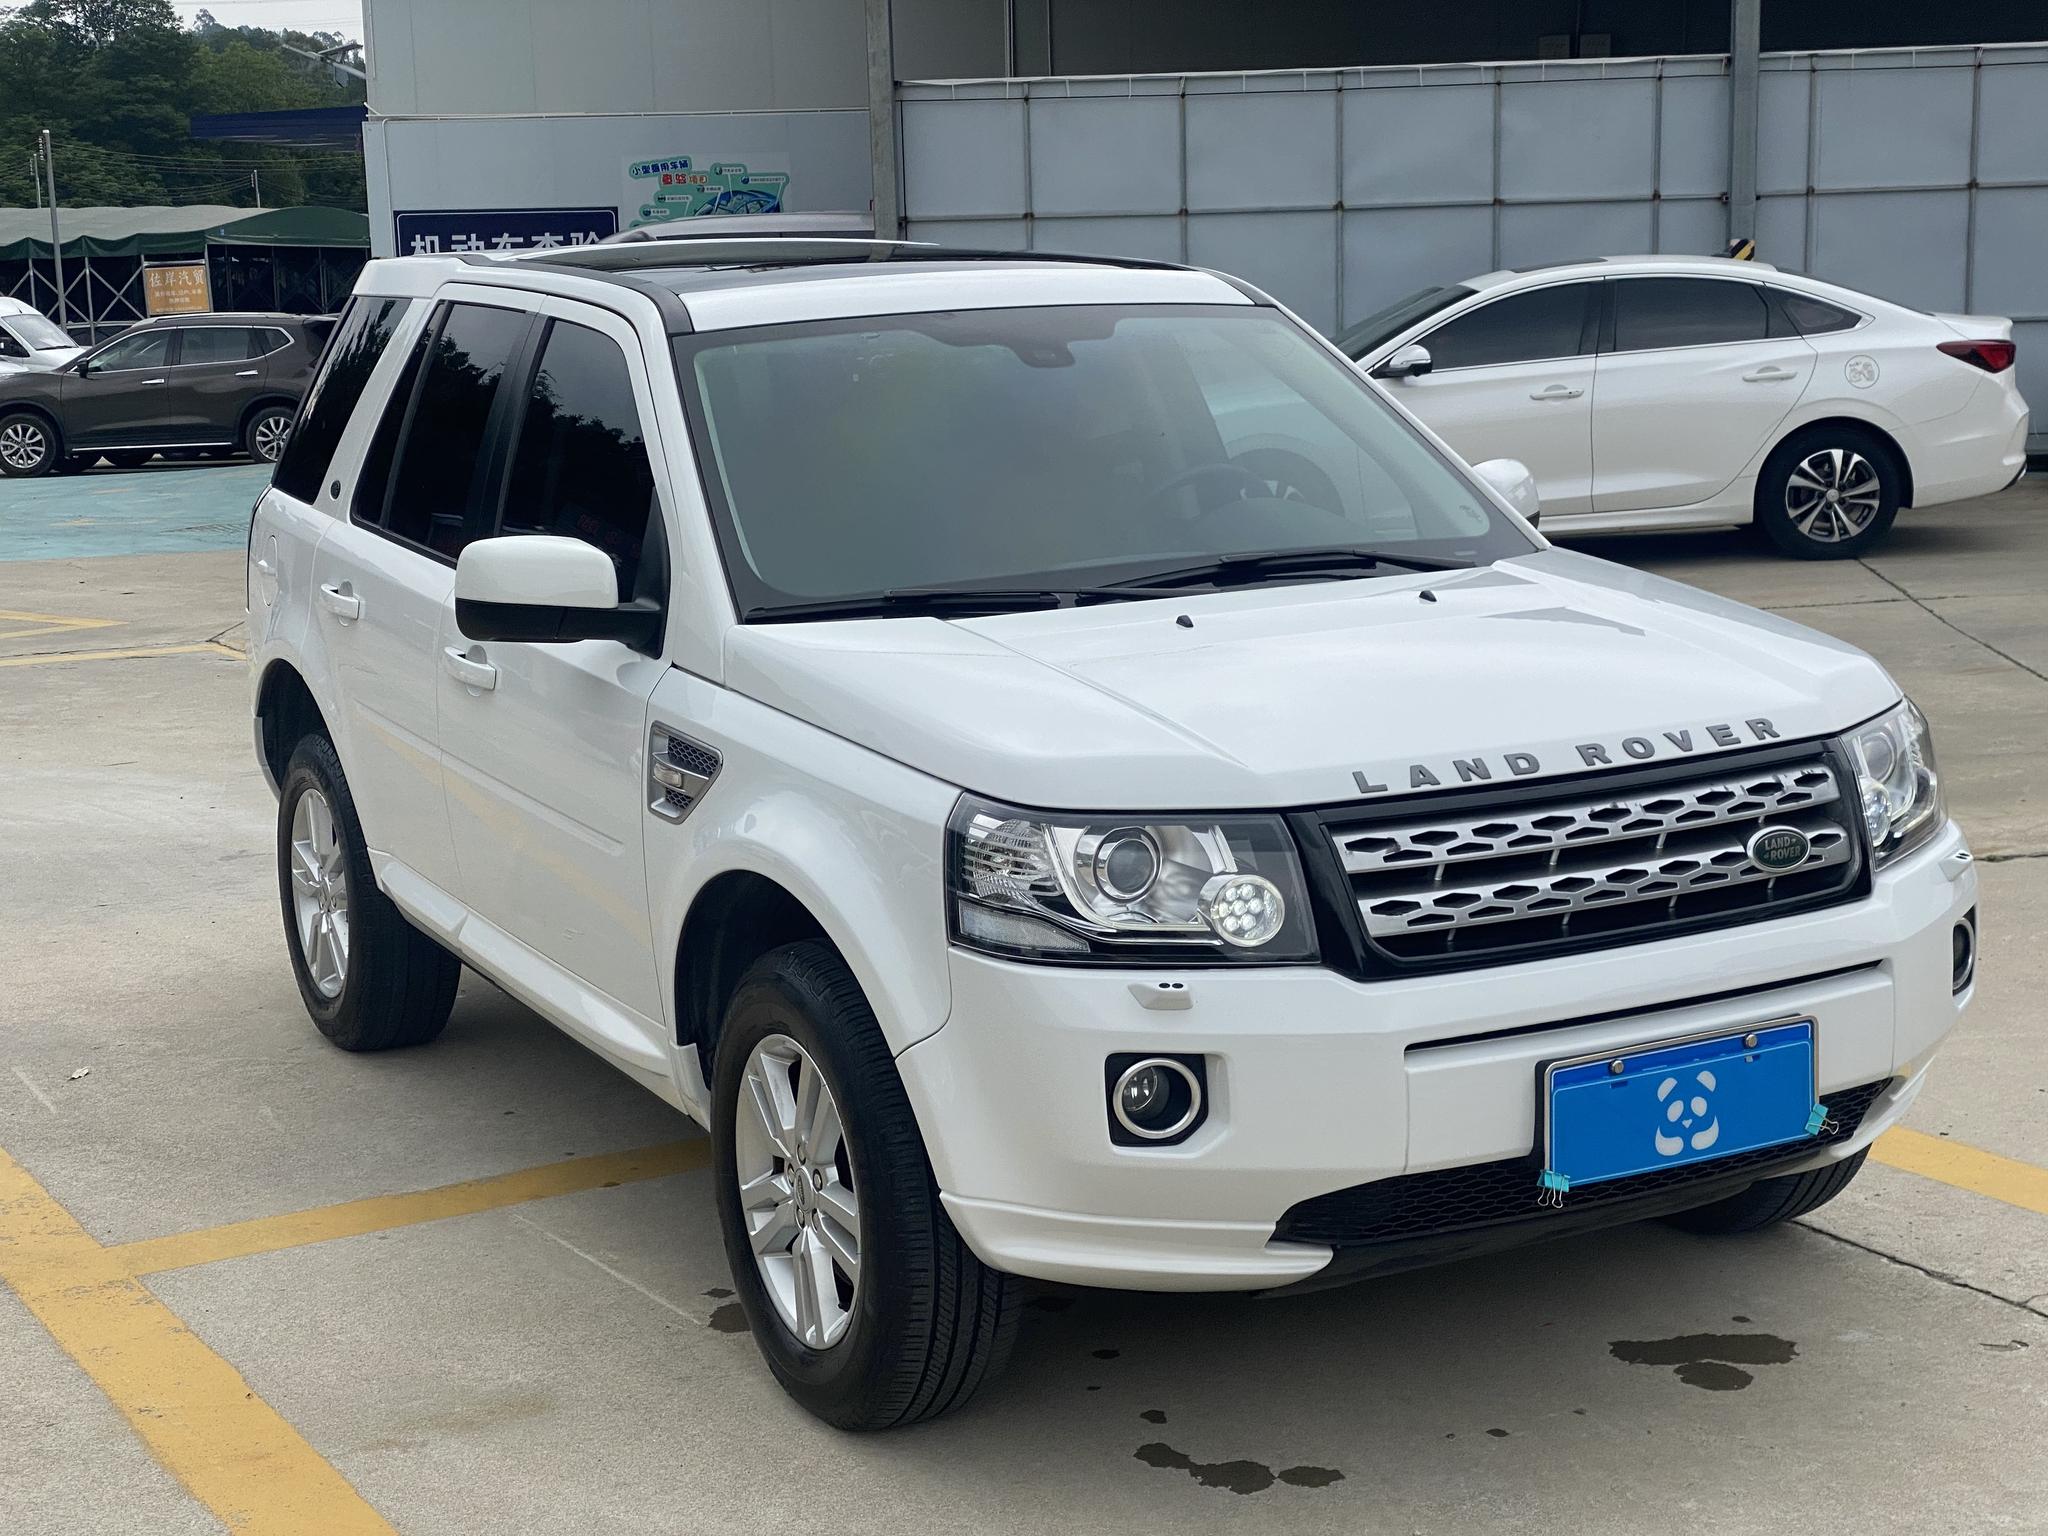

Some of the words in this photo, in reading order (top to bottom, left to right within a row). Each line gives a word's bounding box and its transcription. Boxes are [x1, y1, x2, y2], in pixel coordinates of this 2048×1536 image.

[1352, 752, 1541, 794] LAND
[1575, 718, 1781, 767] ROVER
[1765, 836, 1791, 850] LAND
[1770, 845, 1801, 860] ROVER
